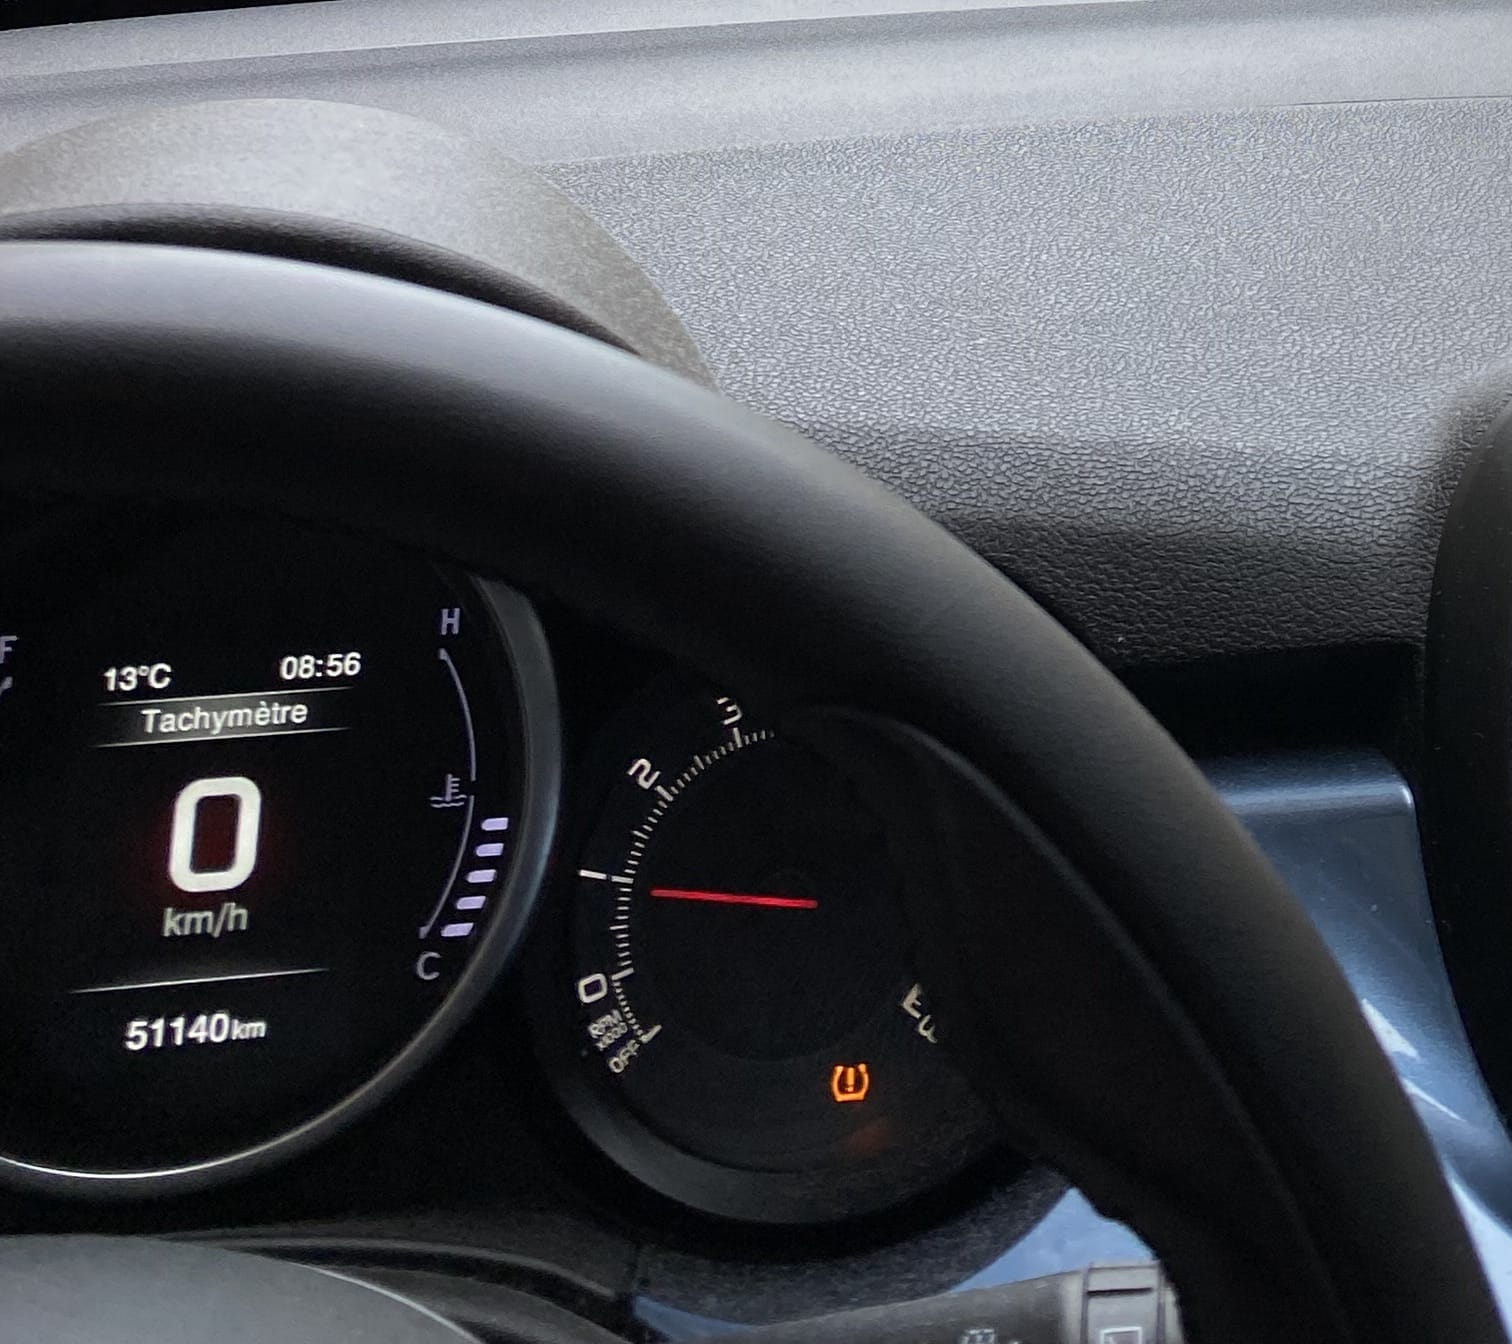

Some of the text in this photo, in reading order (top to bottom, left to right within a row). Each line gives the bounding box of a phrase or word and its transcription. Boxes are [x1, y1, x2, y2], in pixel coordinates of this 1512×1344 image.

[440, 608, 460, 635] H
[104, 663, 172, 692] 13°C
[280, 652, 361, 680] 08:56
[141, 700, 309, 736] Tachymètre
[628, 758, 661, 790] 2
[168, 776, 262, 893] 0
[161, 903, 250, 939] km/h
[416, 952, 442, 980] C
